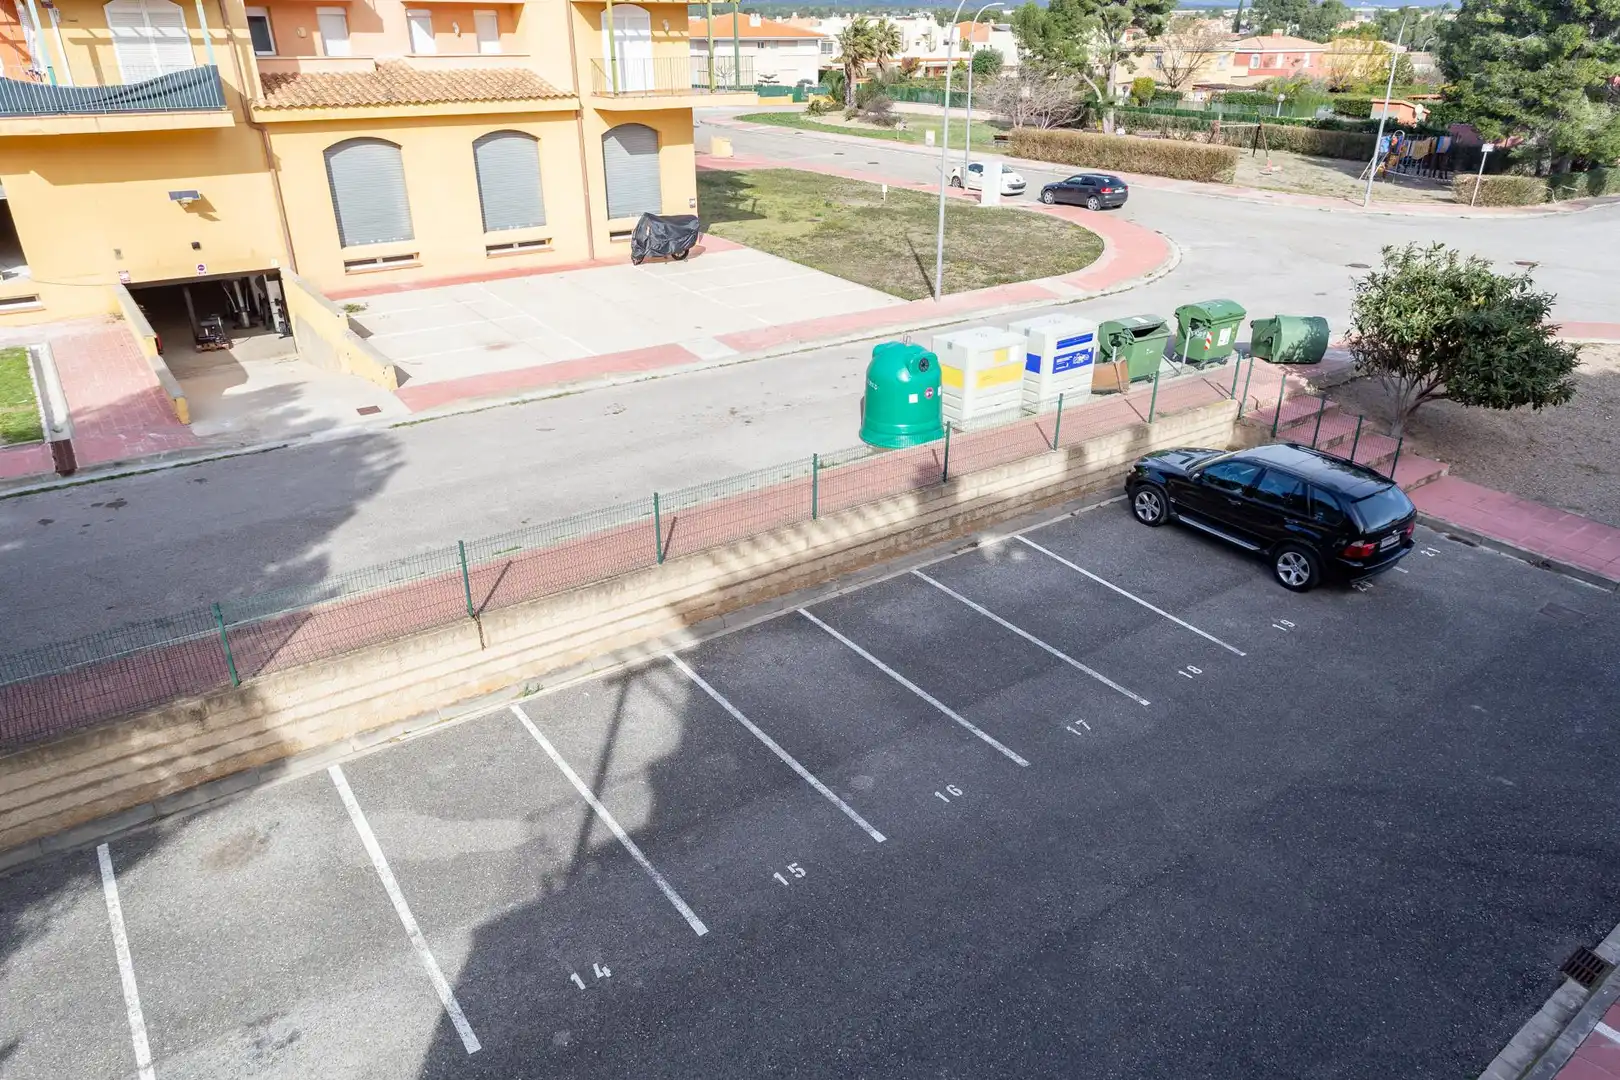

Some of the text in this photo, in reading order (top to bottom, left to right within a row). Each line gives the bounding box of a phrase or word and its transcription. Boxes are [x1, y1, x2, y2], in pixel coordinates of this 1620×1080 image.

[1272, 619, 1295, 631] 19
[1178, 665, 1203, 679] 18
[1066, 719, 1091, 736] 17
[934, 784, 963, 803] 16
[773, 862, 806, 886] 15
[570, 962, 612, 990] 14
